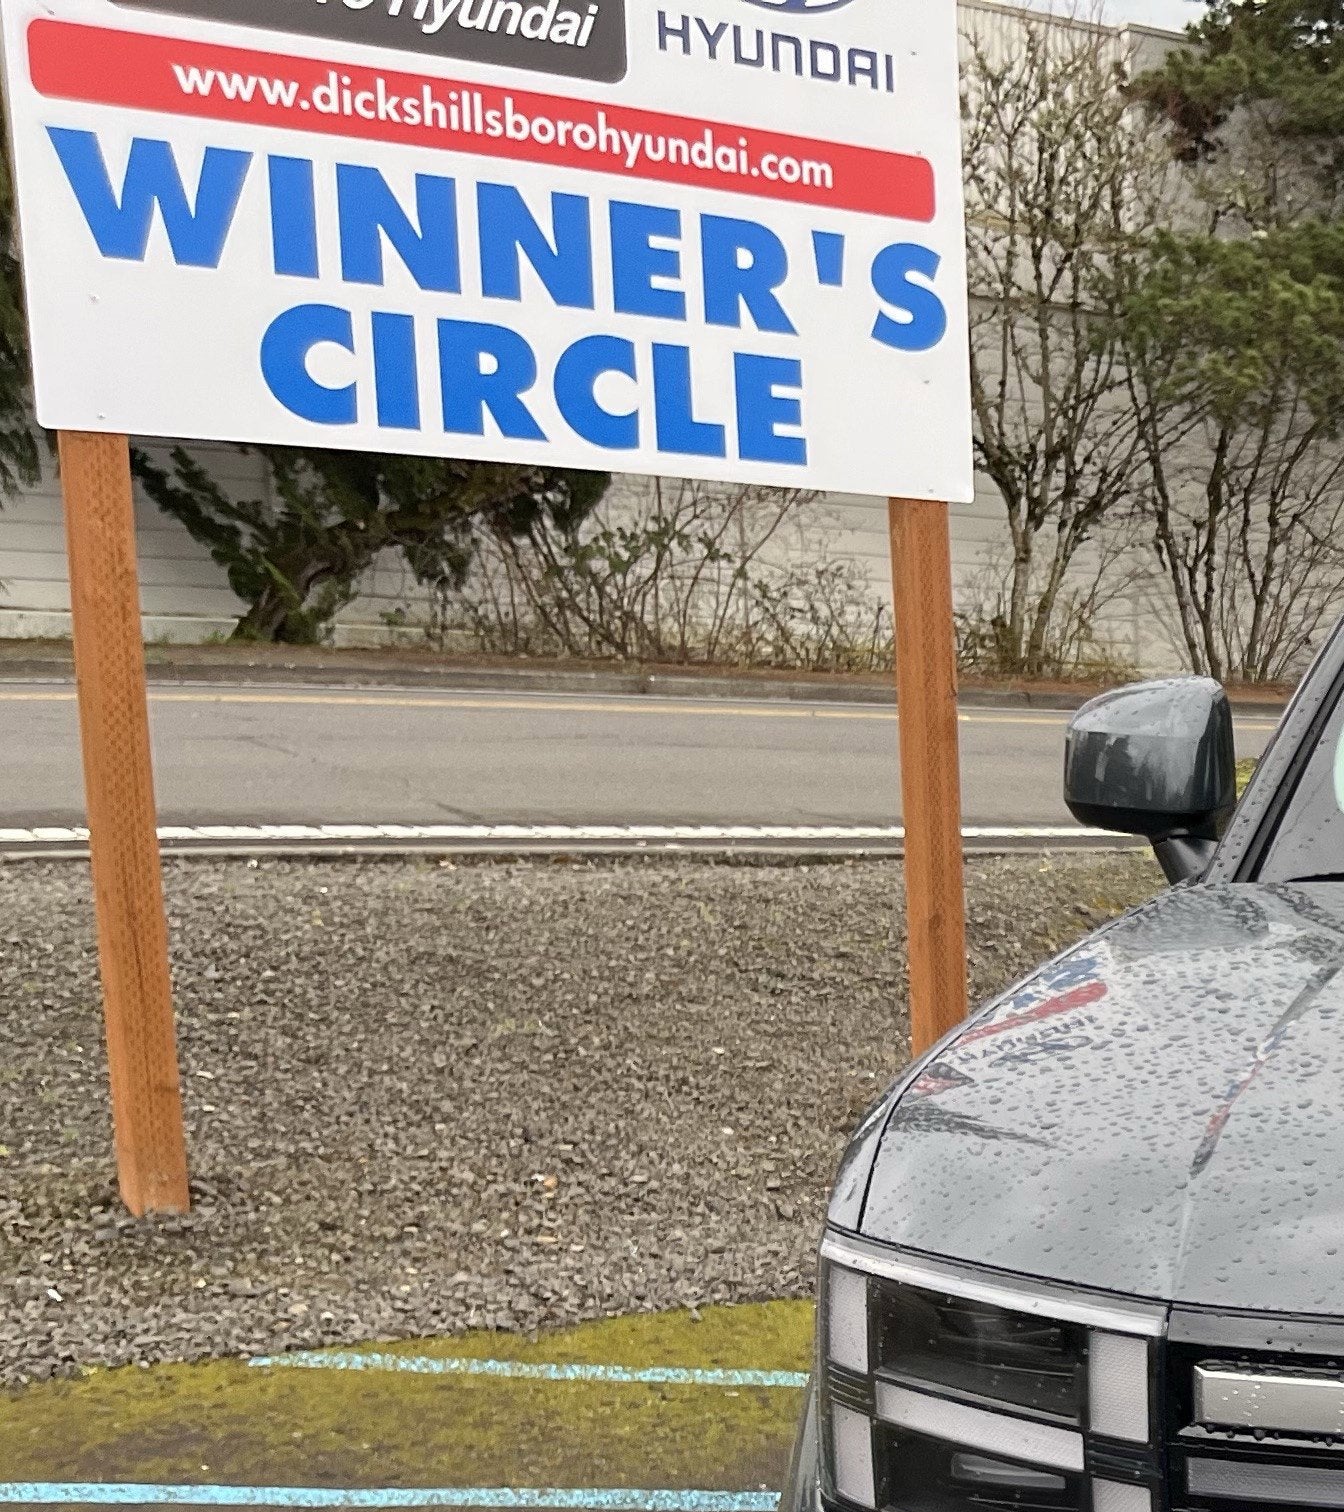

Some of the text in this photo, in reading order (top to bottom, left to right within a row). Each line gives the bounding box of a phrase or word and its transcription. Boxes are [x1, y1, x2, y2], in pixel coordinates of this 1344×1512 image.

[656, 10, 895, 93] HYUNDAI
[171, 62, 834, 190] www.dickshillsborohyundai.com
[45, 126, 948, 353] WINNER'S
[260, 303, 808, 467] CIRCLE
